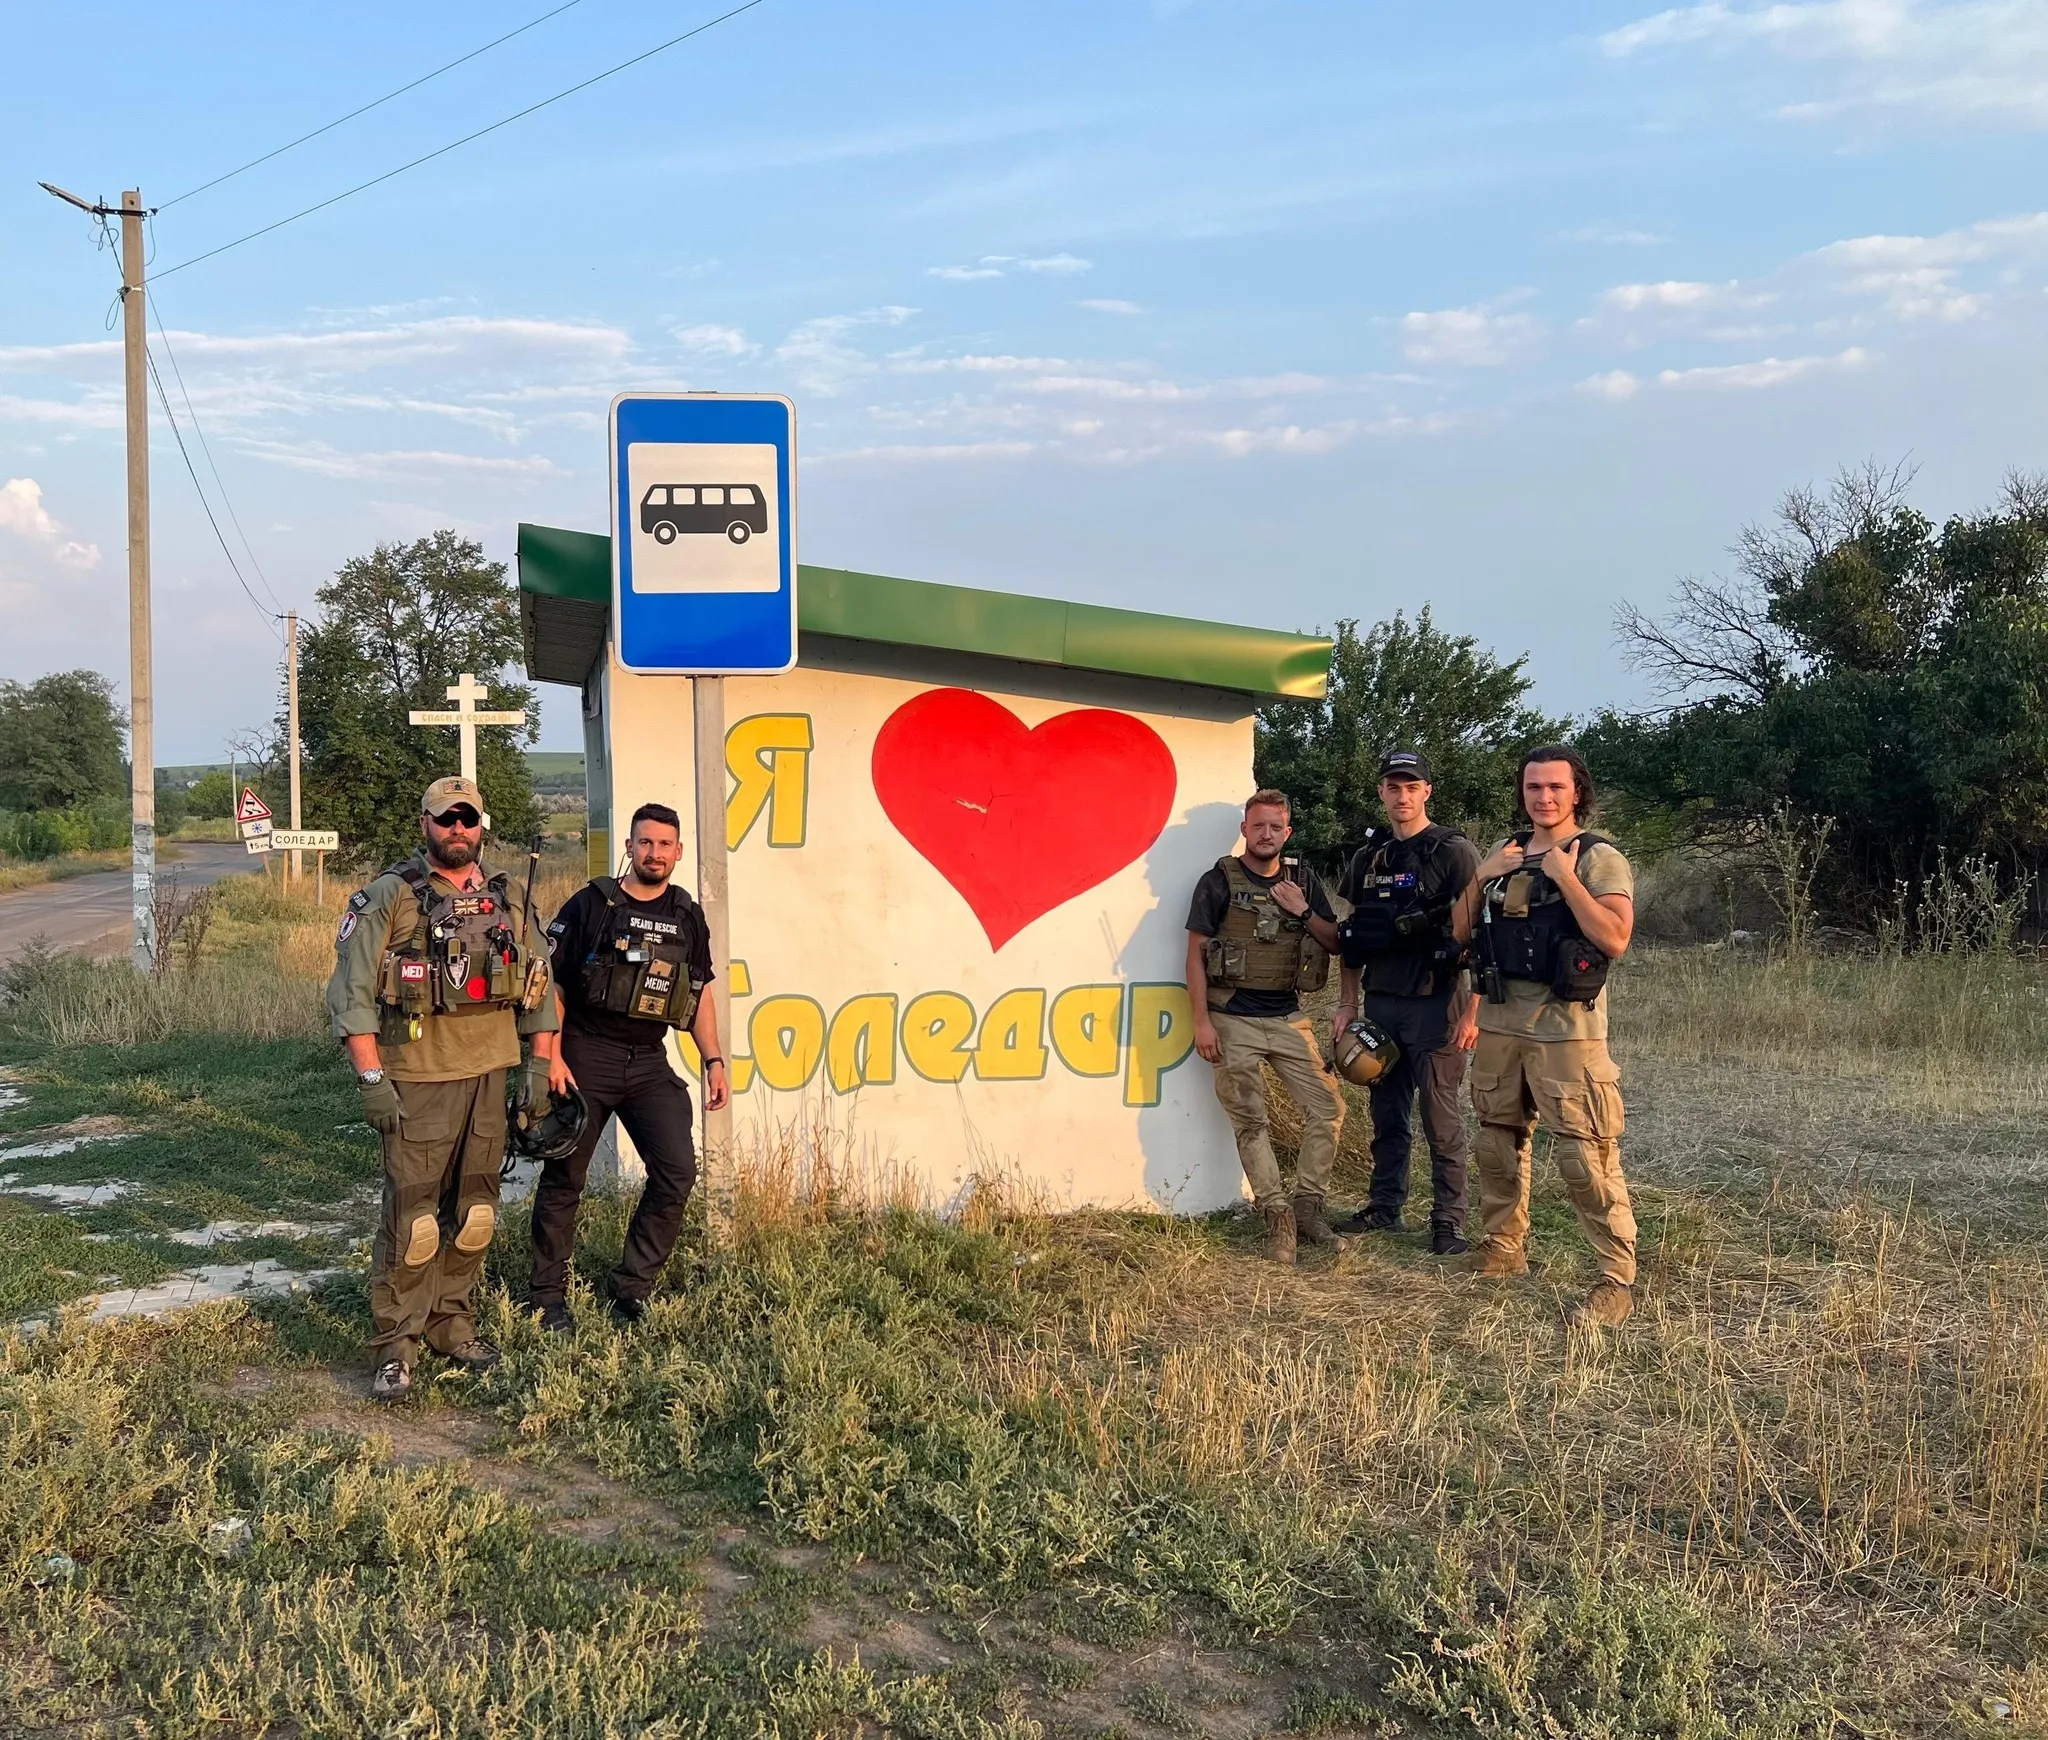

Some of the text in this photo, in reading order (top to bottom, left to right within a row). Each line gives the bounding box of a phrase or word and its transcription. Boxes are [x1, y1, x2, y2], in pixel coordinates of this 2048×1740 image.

[724, 712, 814, 853] Я
[275, 835, 334, 846] СОЛЕДАР
[654, 921, 678, 935] RESCUE
[401, 965, 424, 979] MED
[644, 976, 670, 992] MEDIC
